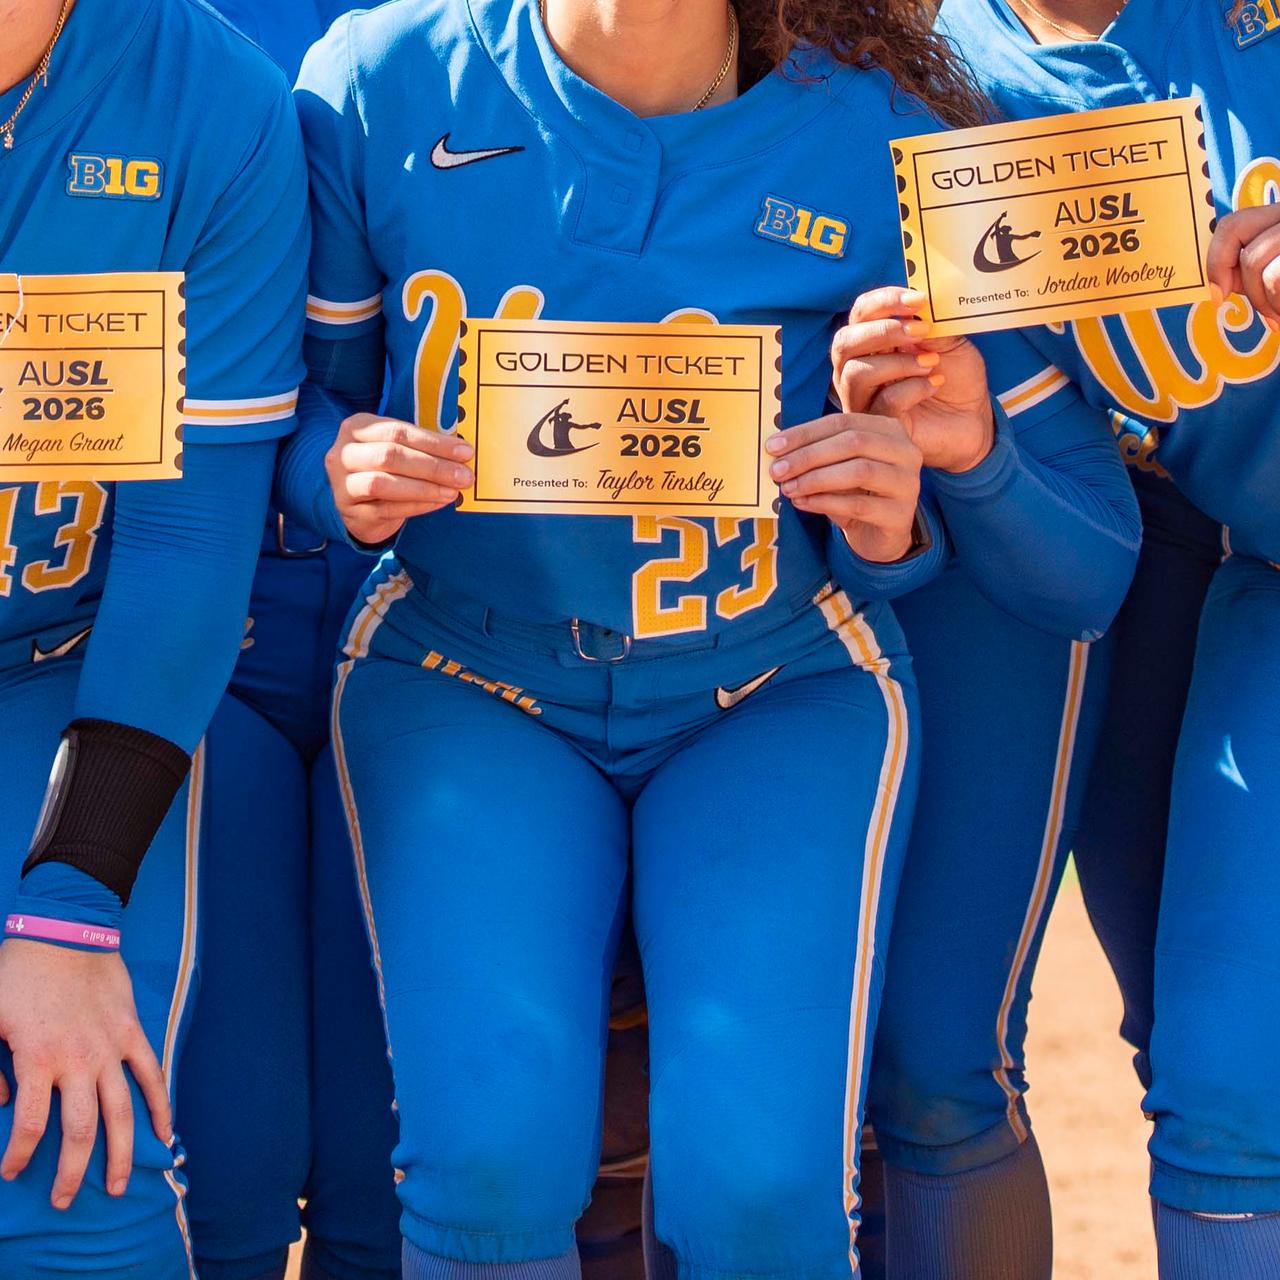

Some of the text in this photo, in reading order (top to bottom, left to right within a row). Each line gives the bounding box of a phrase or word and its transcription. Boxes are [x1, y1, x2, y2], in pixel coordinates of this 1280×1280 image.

[932, 140, 1168, 190] GOLDEN TICKET
[1054, 192, 1138, 227] AUSL
[1060, 228, 1140, 260] 2026
[959, 262, 1175, 306] Presented To: Jordan Woolery
[37, 312, 147, 333] TICKET
[18, 360, 108, 387] AUSL
[495, 352, 745, 376] GOLDEN TICKET
[23, 397, 105, 420] 2026
[616, 398, 706, 424] AUSL
[3, 432, 63, 461] Megan
[69, 432, 124, 451] Grant
[620, 434, 702, 458] 2026
[513, 469, 724, 502] Presented To: Taylor Tinsley
[632, 515, 779, 640] 23
